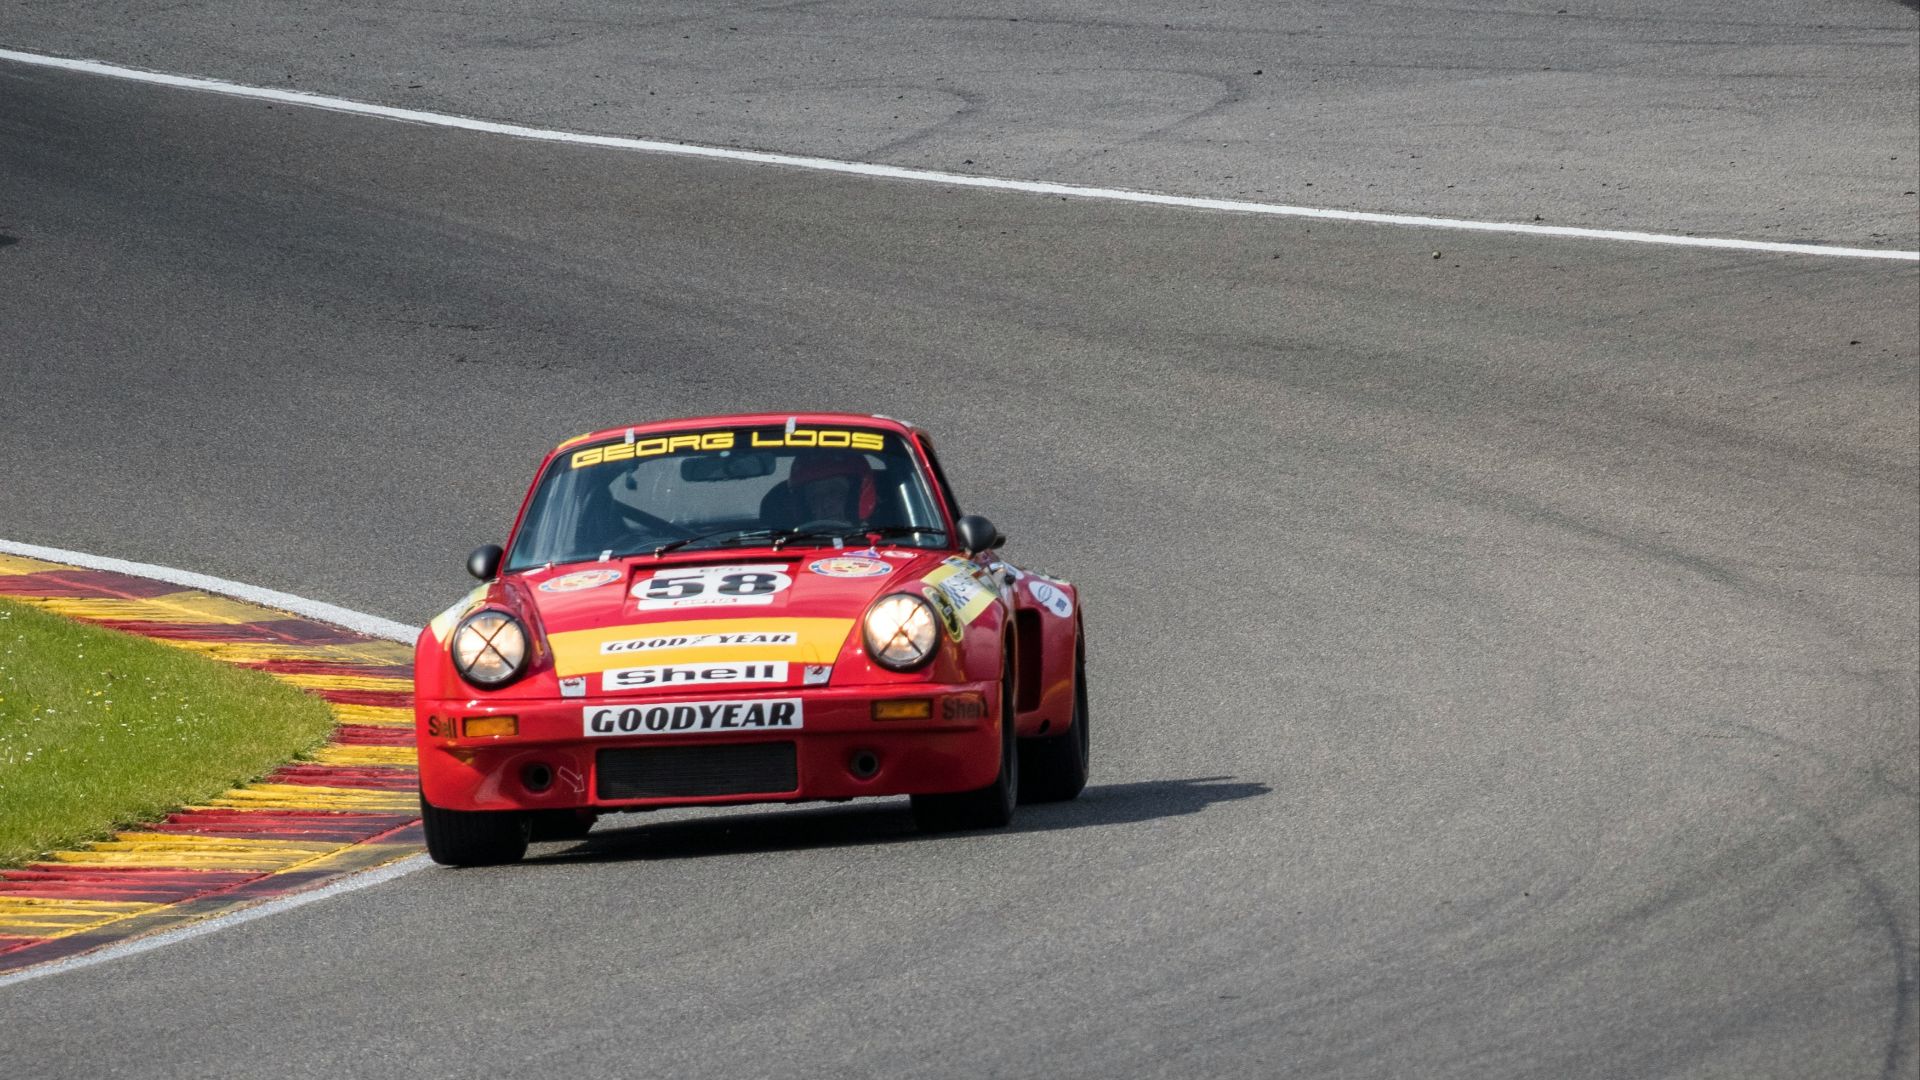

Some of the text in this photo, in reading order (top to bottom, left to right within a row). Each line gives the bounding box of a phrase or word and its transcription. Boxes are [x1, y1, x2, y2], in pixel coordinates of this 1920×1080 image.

[571, 430, 884, 469] GEORG LOOS
[646, 573, 778, 600] 58
[616, 665, 775, 686] Shell
[591, 702, 796, 733] GOODYEAR
